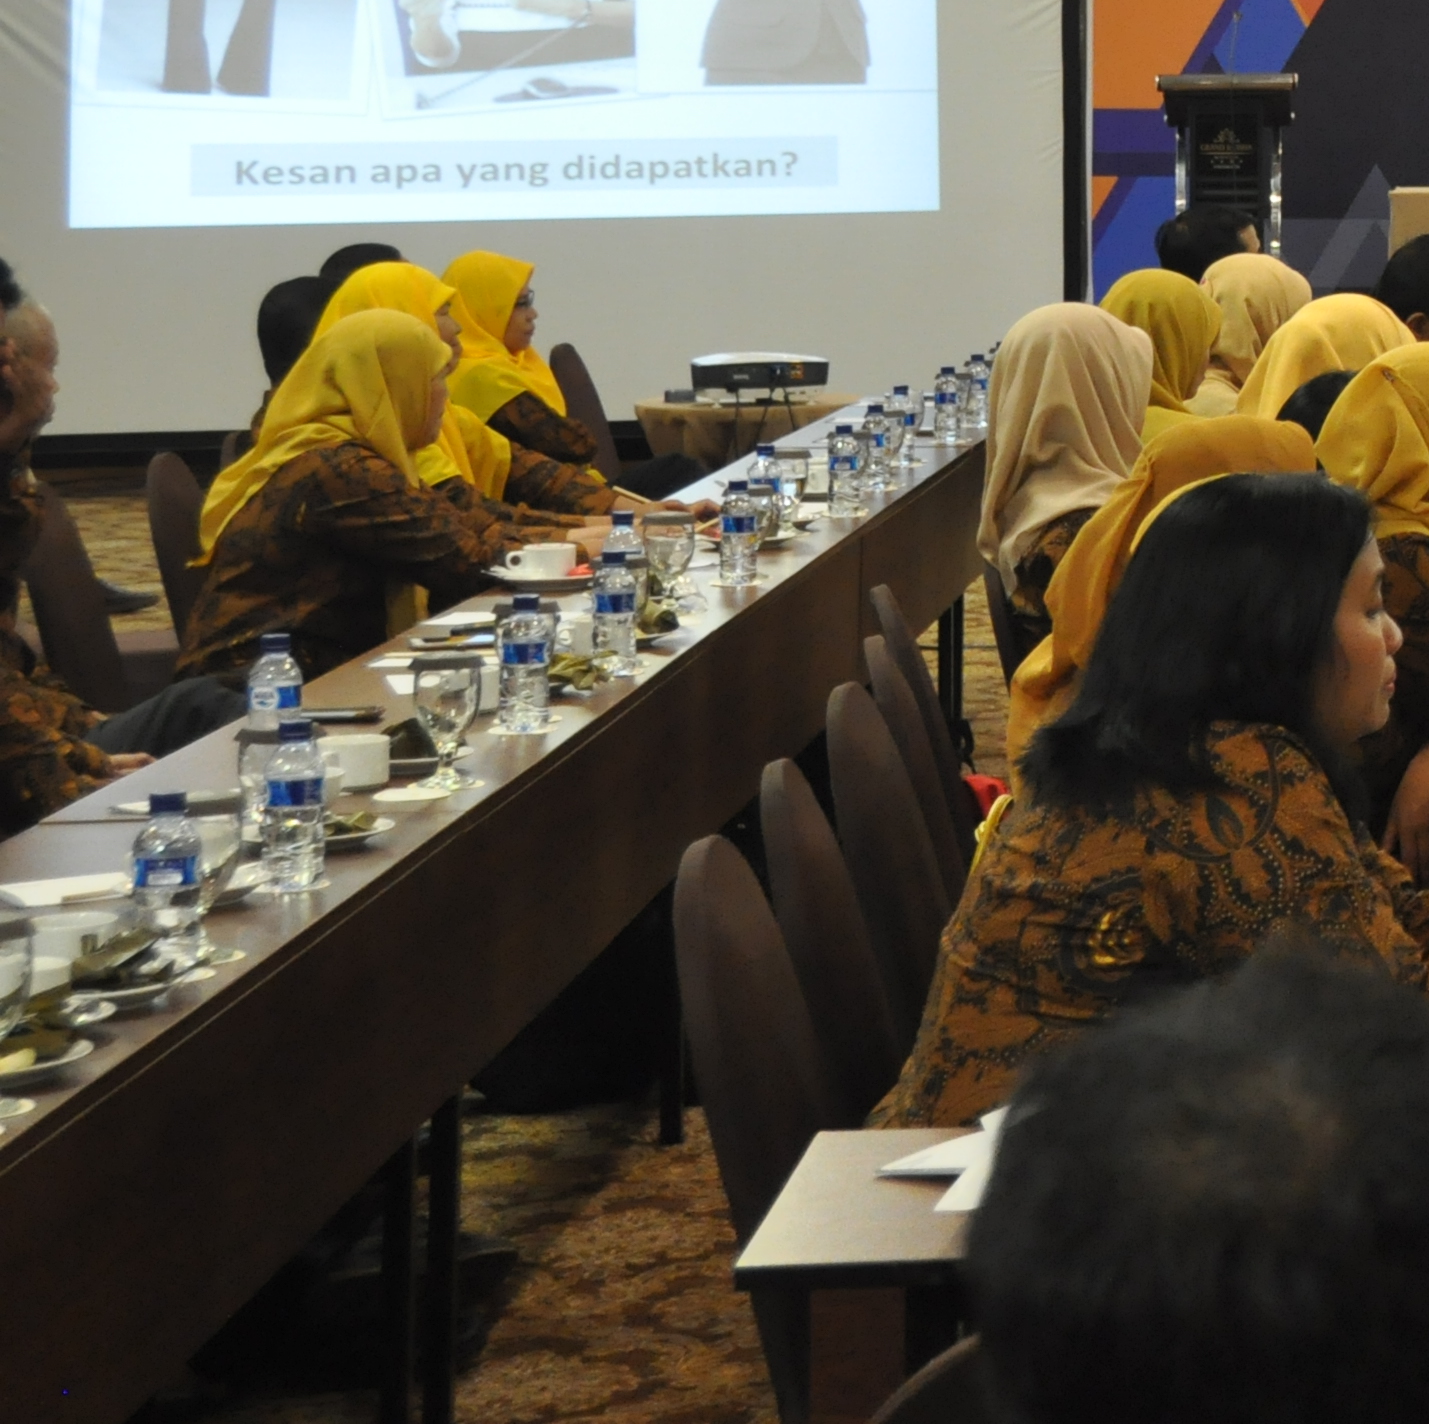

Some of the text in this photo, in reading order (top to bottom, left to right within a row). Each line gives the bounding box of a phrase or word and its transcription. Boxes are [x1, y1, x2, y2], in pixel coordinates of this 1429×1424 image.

[235, 151, 799, 190] Kesan apa yang didapatkan?
